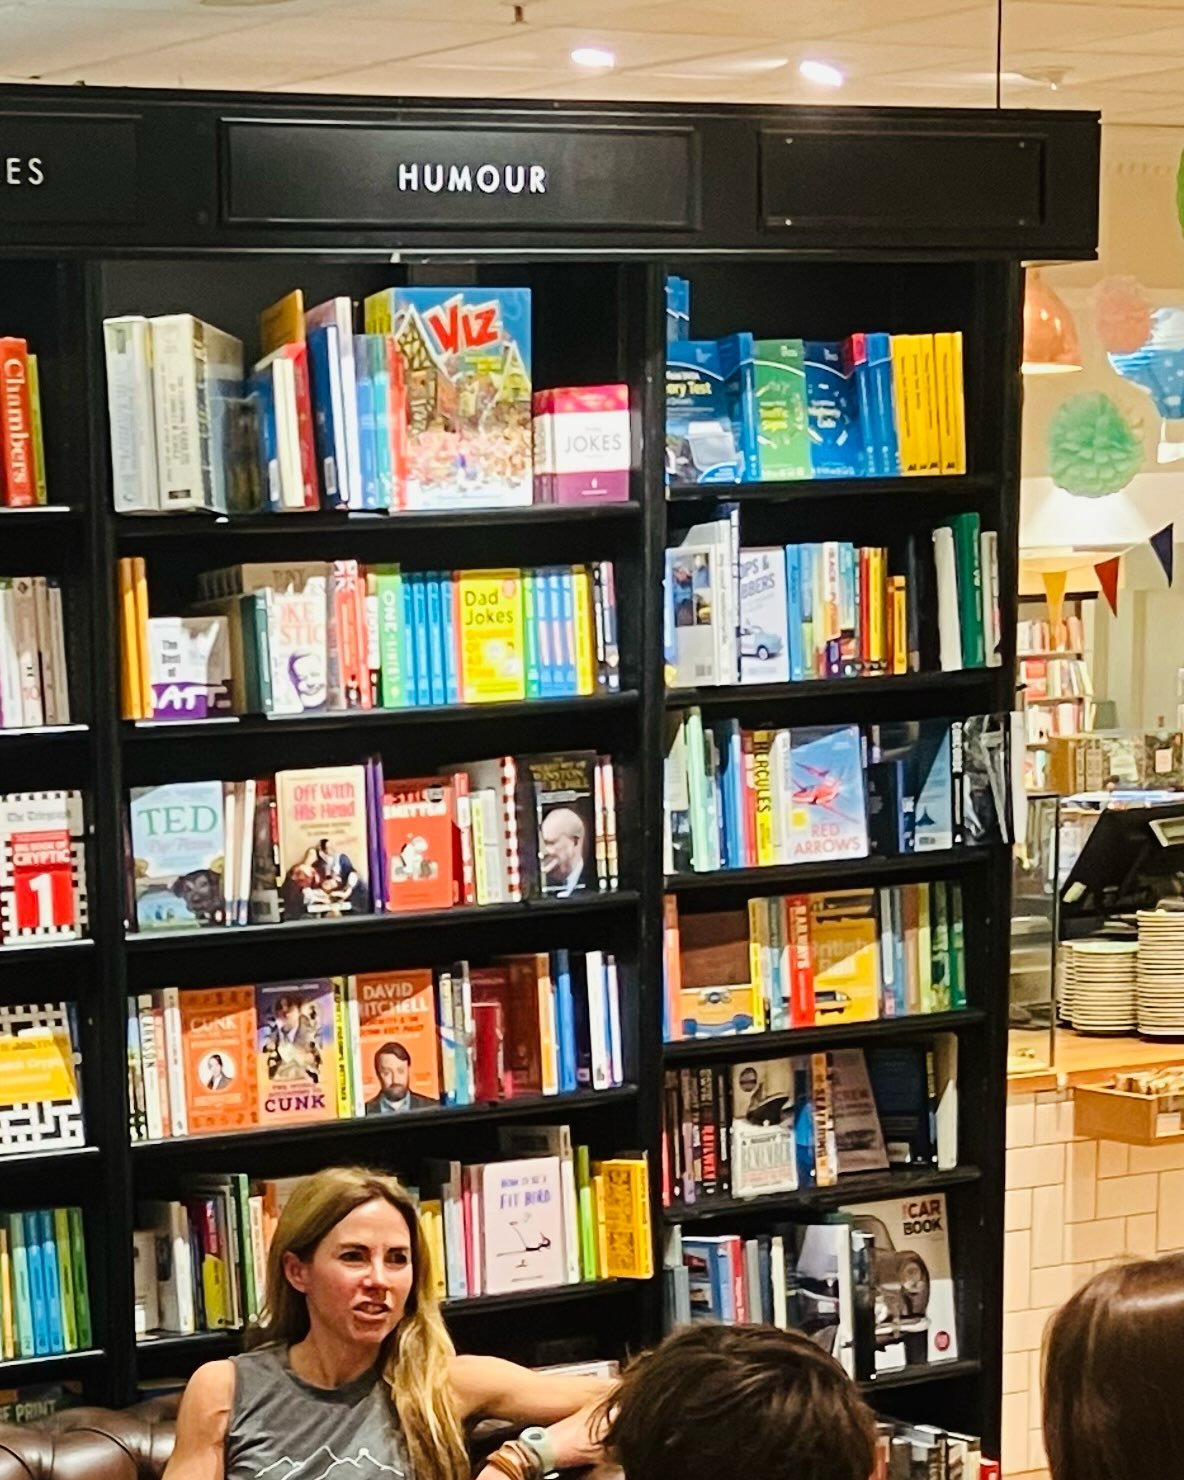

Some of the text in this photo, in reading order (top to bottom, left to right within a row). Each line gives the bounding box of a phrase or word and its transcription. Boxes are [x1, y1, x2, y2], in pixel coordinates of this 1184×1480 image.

[397, 161, 547, 194] HUMOUR
[3, 358, 30, 484] Chambers
[564, 433, 623, 455] JOKES
[465, 590, 500, 607] Dad
[465, 609, 515, 626] Jokes
[753, 741, 772, 814] HERCULES
[137, 804, 218, 836] TED
[810, 822, 841, 839] RED
[794, 836, 862, 856] ARROWS
[12, 850, 71, 867] CRYPTIC
[29, 871, 55, 927] 1
[362, 982, 414, 1000] DAVID
[264, 1094, 326, 1114] CUNK
[908, 1200, 941, 1219] CAR
[903, 1218, 943, 1236] BOOK
[15, 1399, 57, 1423] PRINT
